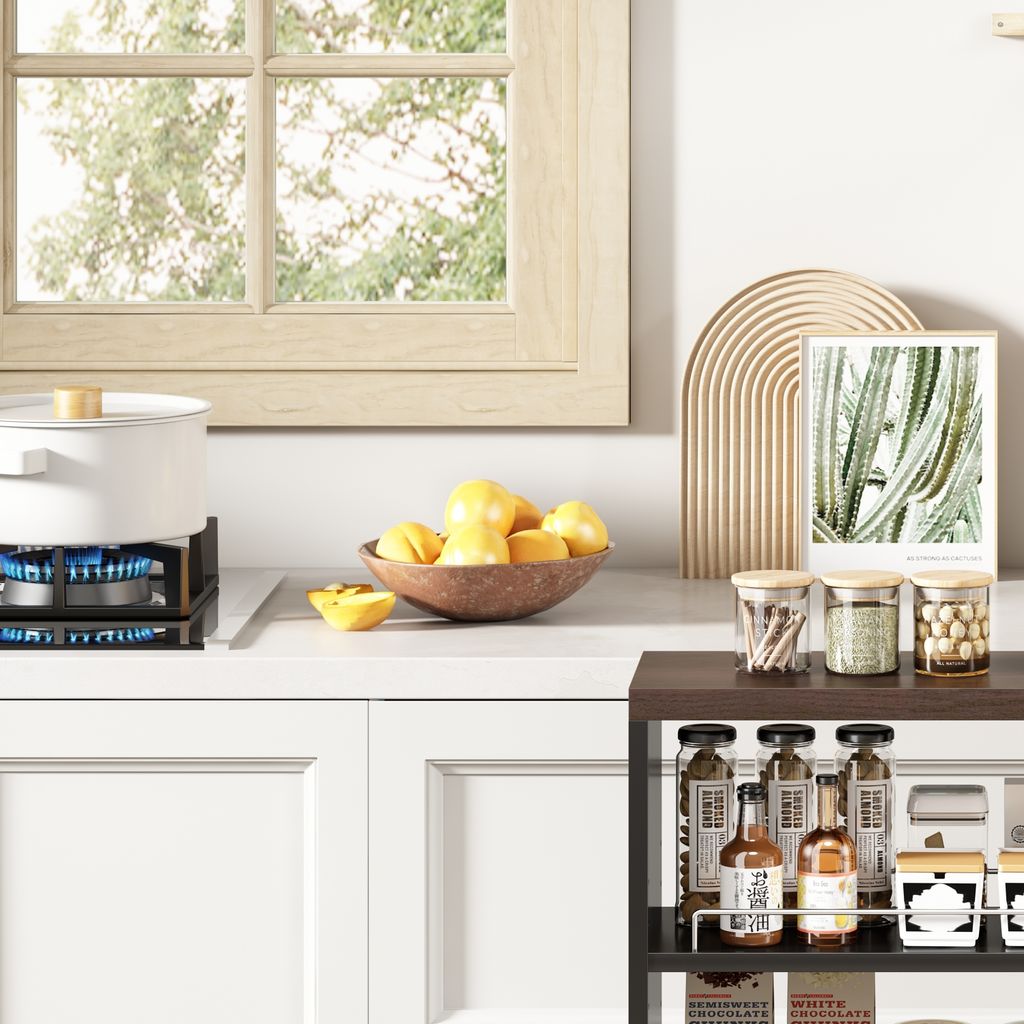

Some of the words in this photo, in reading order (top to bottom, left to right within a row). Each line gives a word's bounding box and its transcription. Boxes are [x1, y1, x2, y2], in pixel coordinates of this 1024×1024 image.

[702, 790, 713, 828] ALMOND
[714, 790, 724, 828] SMOKED
[781, 790, 792, 828] ALMOND
[793, 790, 803, 828] SMOKED
[860, 790, 871, 828] ALMOND
[872, 790, 882, 828] SMOKED
[719, 834, 726, 845] 03
[877, 834, 884, 845] 03
[790, 1000, 846, 1008] WHITE
